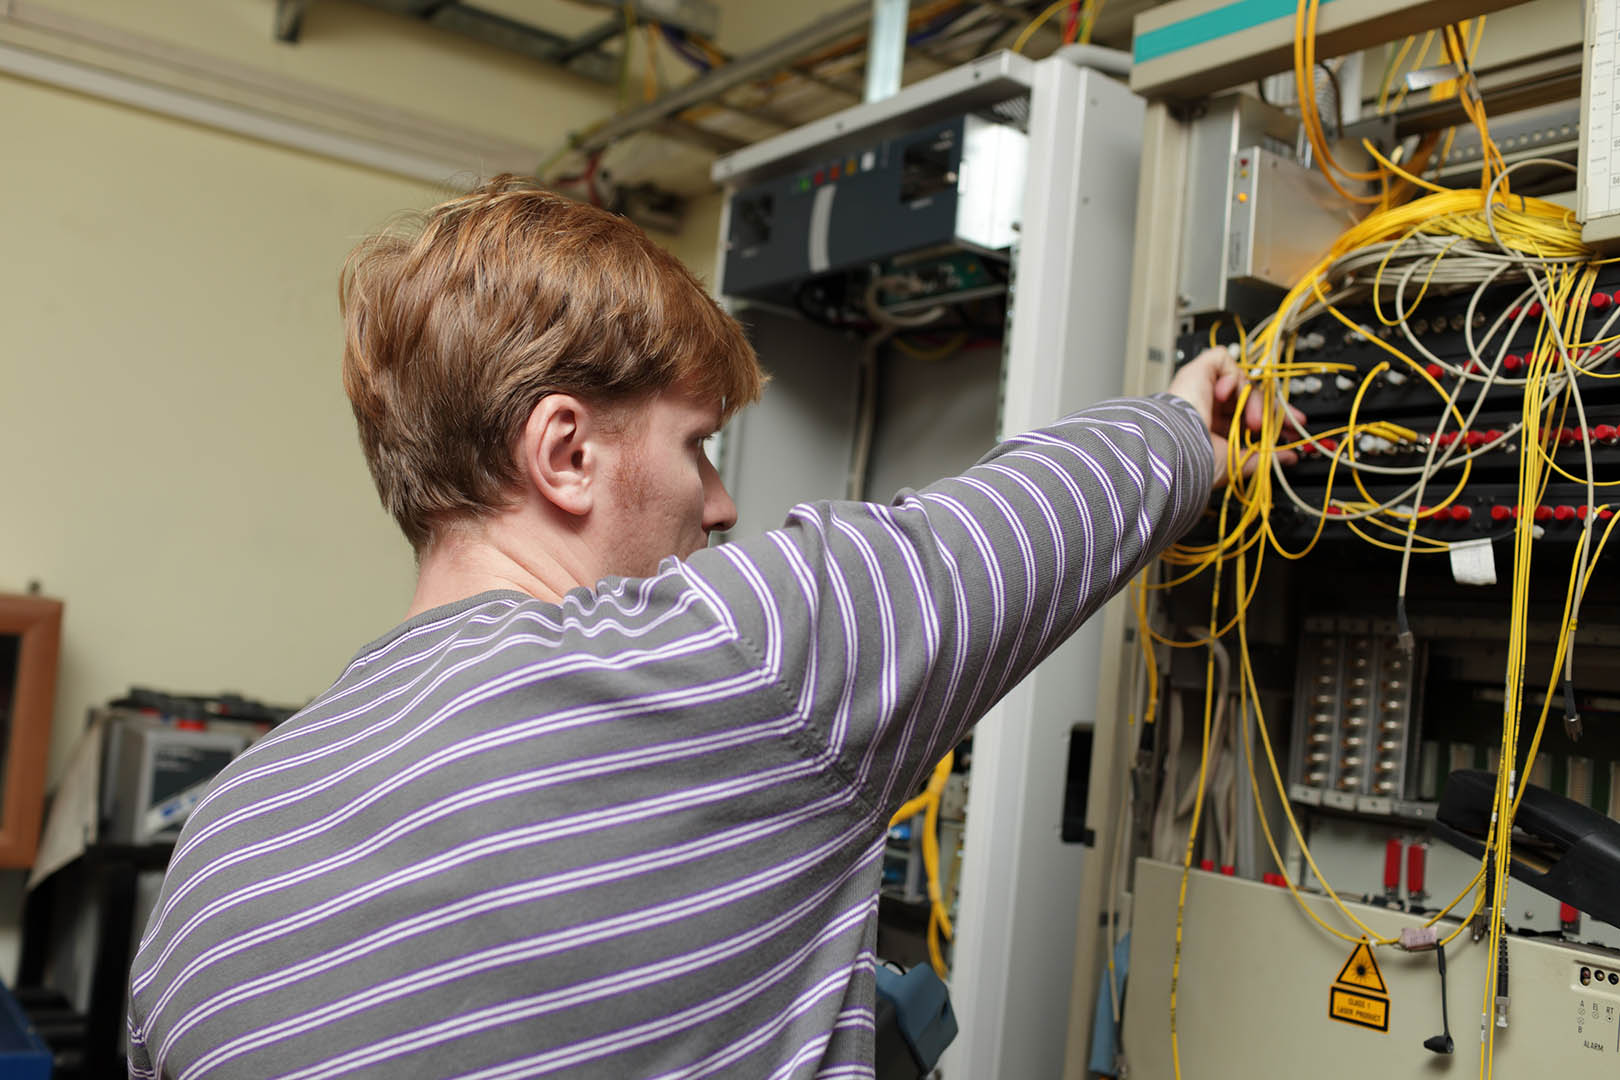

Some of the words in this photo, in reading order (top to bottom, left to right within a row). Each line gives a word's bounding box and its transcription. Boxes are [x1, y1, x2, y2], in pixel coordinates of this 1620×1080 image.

[1336, 1005, 1353, 1015] LASER
[1356, 1010, 1381, 1022] PRODUCT
[1583, 1040, 1604, 1052] ALARM
